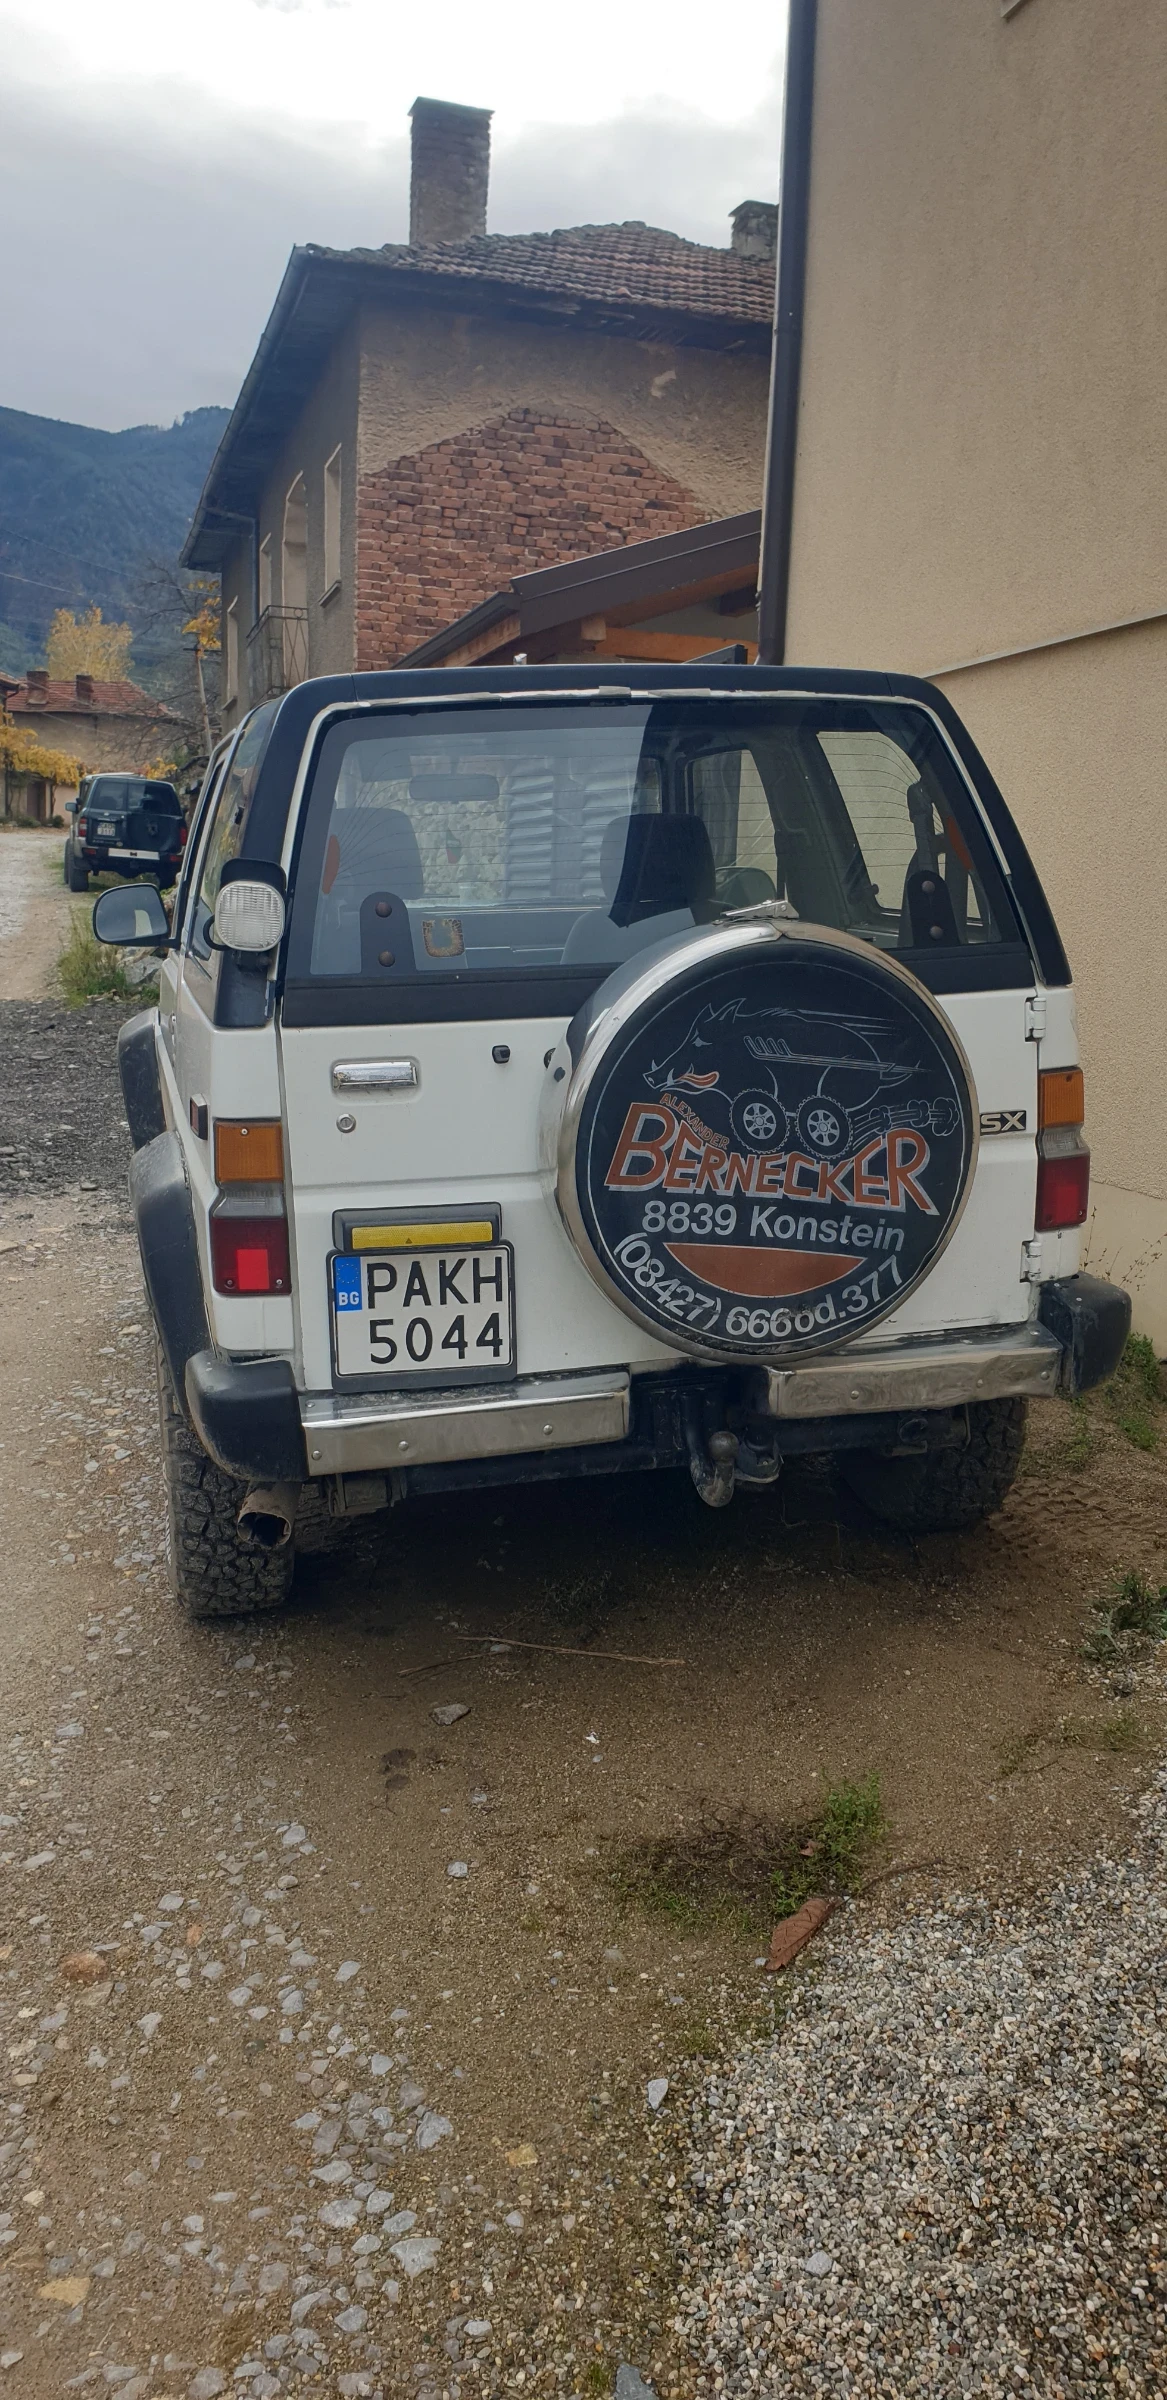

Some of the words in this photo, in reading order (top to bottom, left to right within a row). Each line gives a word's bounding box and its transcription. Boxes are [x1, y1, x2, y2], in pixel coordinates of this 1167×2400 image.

[660, 1092, 730, 1150] ALEXANDER
[980, 1111, 1025, 1133] SX
[605, 1102, 940, 1216] BERNECKER
[642, 1201, 737, 1236] 8839
[750, 1205, 905, 1252] Konstein
[338, 1291, 360, 1306] BG
[366, 1256, 503, 1309] PAKH
[613, 1232, 722, 1330] (08427)
[369, 1312, 503, 1364] 5044
